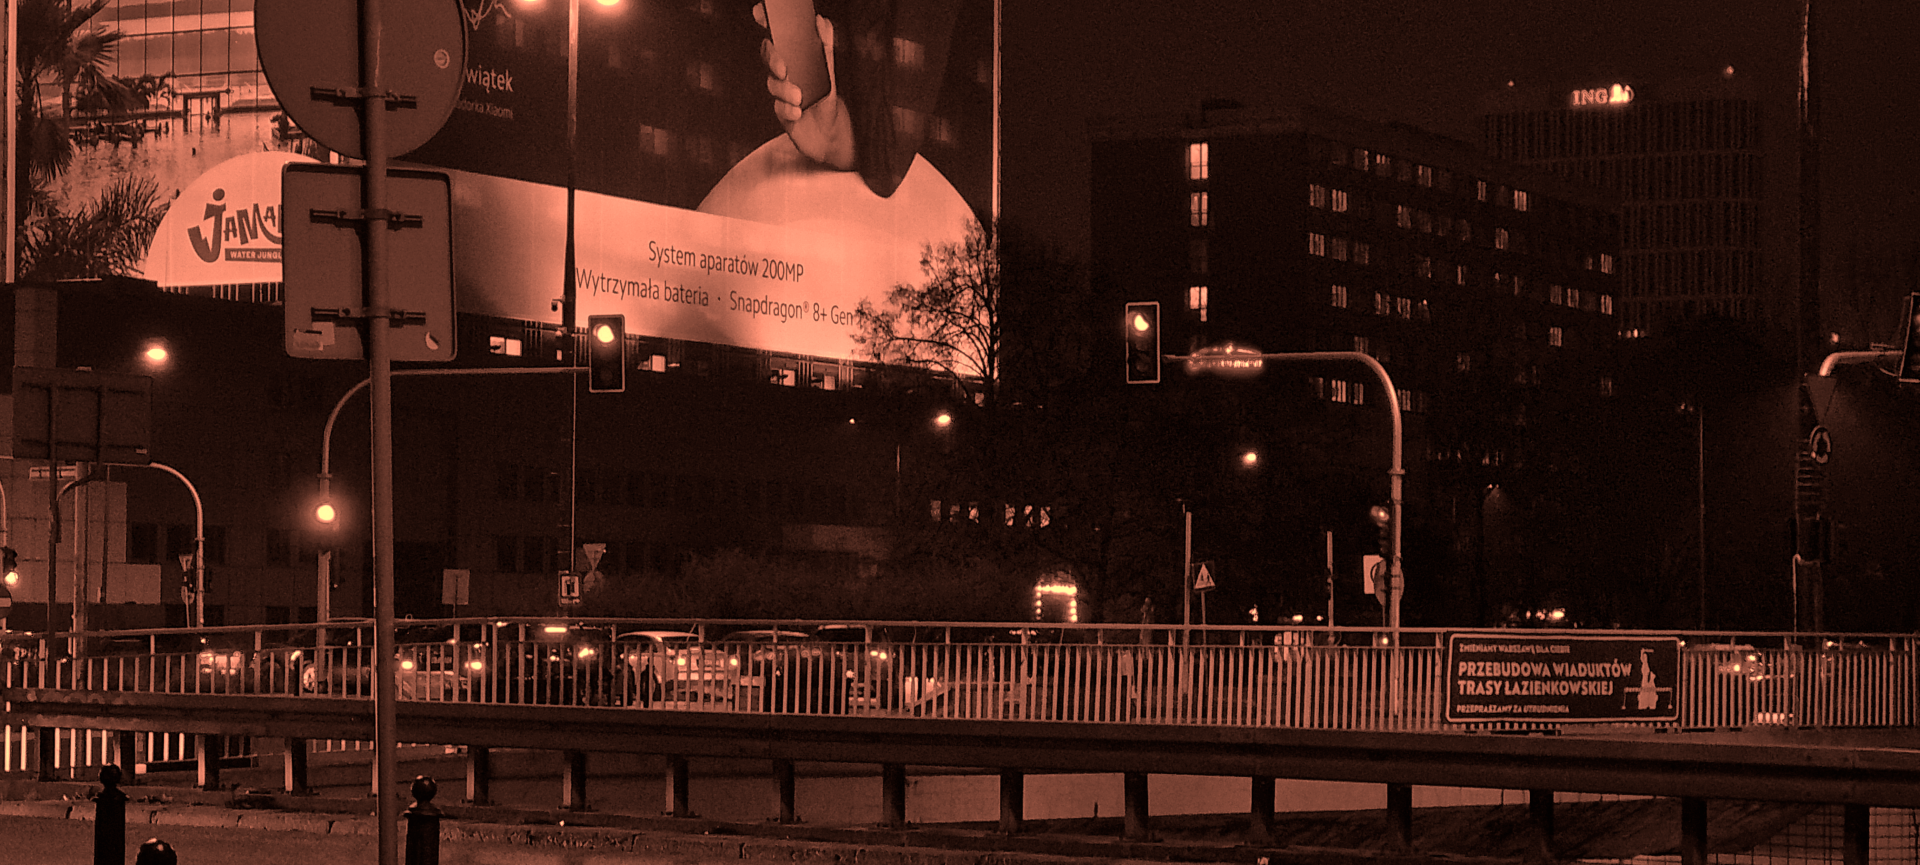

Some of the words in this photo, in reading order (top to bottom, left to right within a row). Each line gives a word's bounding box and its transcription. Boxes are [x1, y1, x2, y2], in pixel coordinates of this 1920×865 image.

[466, 64, 514, 94] wiątek
[1572, 88, 1609, 106] ING
[230, 251, 256, 259] WATER
[257, 251, 282, 260] JUNGL
[648, 240, 696, 269] System
[699, 253, 759, 277] aparatów
[762, 258, 804, 284] 200MP
[576, 267, 660, 301] Wytrzymała
[664, 280, 709, 307] bateria
[812, 302, 828, 323] 8+
[830, 305, 854, 327] Gen
[1535, 645, 1550, 654] DLA
[1550, 645, 1571, 654] CIEBIE
[1458, 661, 1551, 678] PRZEBUDOWA
[1552, 658, 1633, 678] WIADUKTÓW
[1457, 680, 1503, 696] TRASY
[1503, 680, 1614, 697] ŁAZIENKOWSKIEJ
[1456, 704, 1513, 714] PRZEPRASZAMY
[1513, 705, 1522, 713] ZA
[1522, 705, 1570, 714] UTRUDNIENIA
